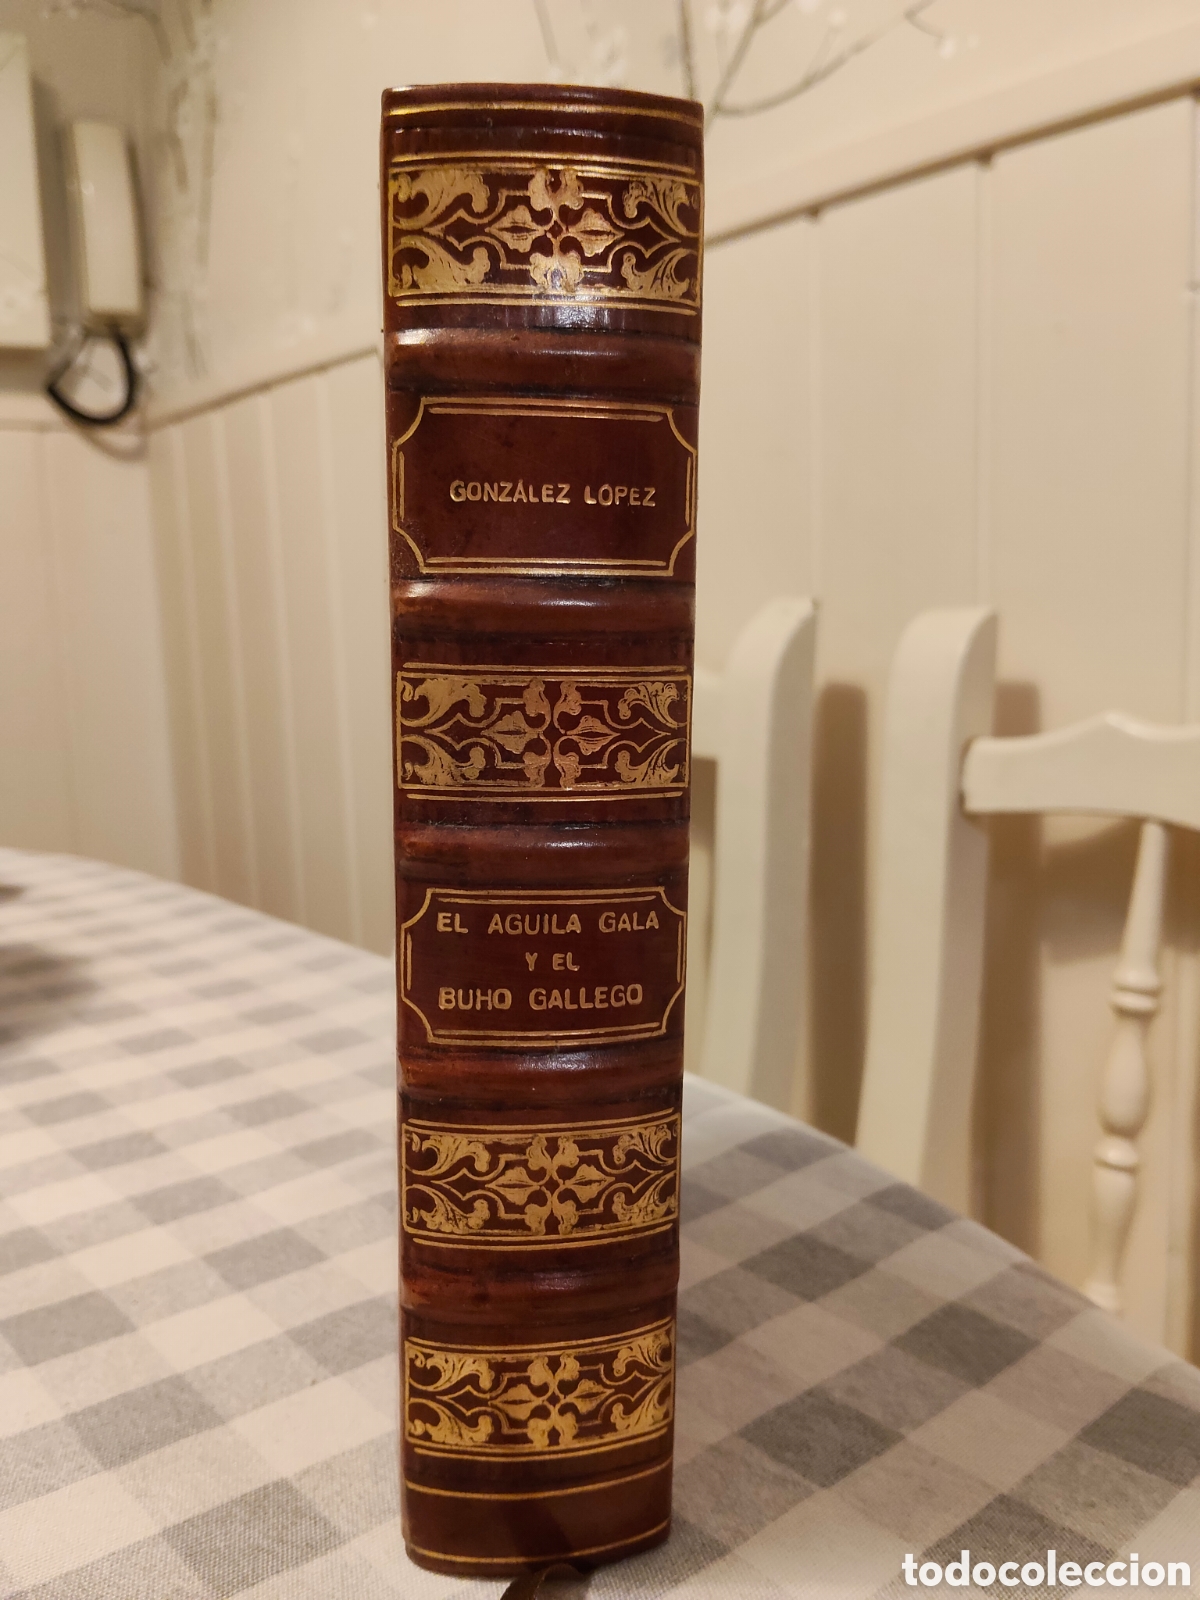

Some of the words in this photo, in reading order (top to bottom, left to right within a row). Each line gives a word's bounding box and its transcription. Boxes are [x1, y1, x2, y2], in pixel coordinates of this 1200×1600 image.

[436, 912, 469, 934] EL
[487, 913, 582, 935] AGUILA
[598, 910, 660, 933] GALA
[525, 951, 538, 972] Y
[552, 951, 581, 972] EL
[438, 986, 513, 1011] BUHO
[528, 983, 643, 1011] GALLEGO
